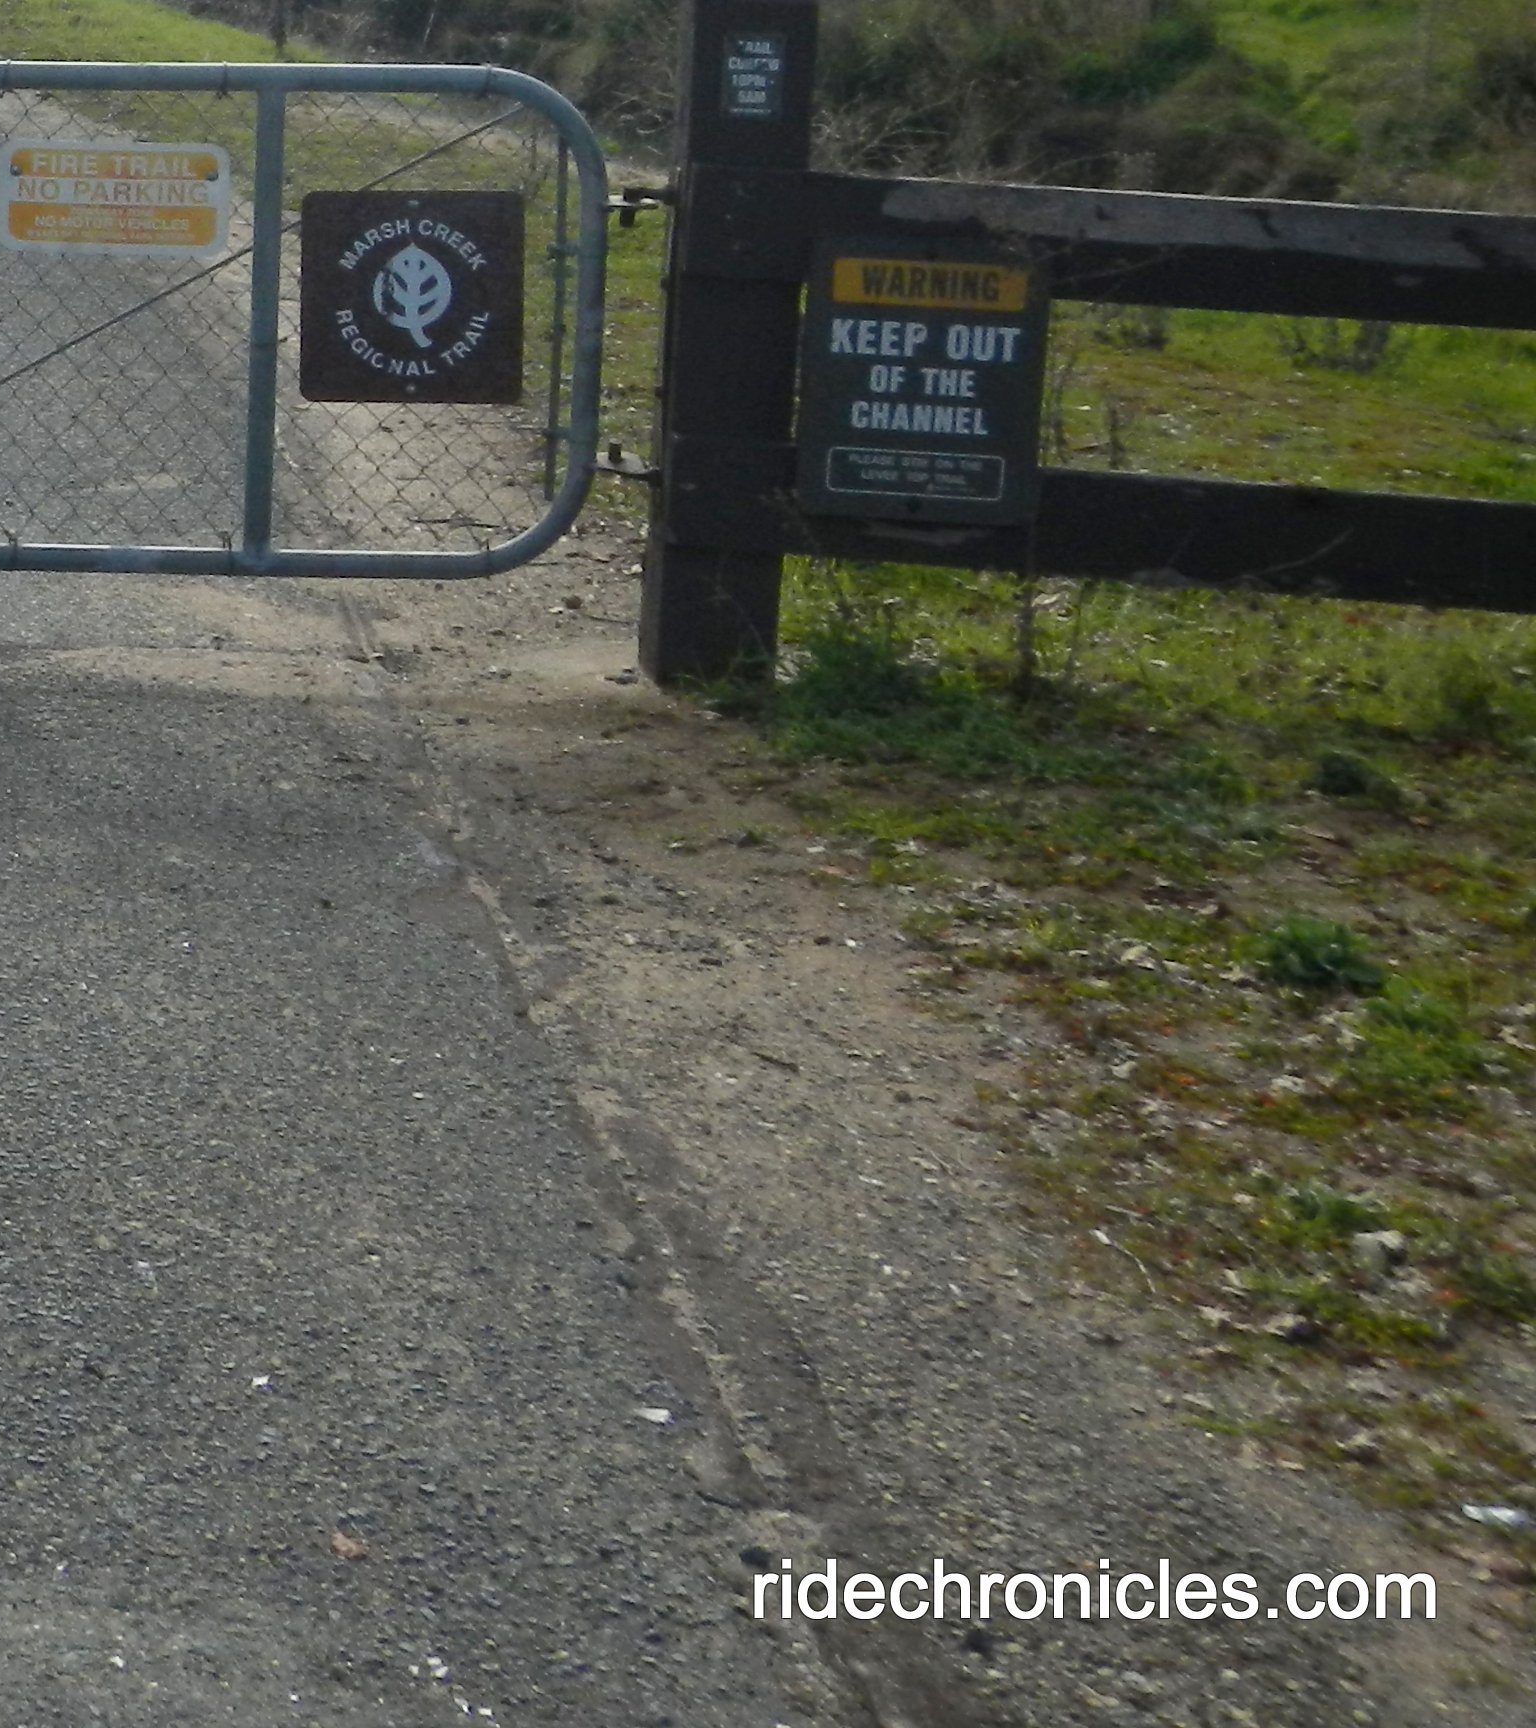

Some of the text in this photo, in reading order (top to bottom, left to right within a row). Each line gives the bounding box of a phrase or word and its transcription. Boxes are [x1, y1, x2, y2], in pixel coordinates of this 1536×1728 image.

[31, 152, 198, 178] FIRE TRAIL
[16, 178, 210, 204] NO PARKING
[33, 215, 57, 228] NO
[119, 218, 190, 231] VEHICLES
[336, 217, 488, 272] MARSH CREEK
[862, 264, 1000, 303] WARNING
[439, 310, 490, 367] TRAIL
[830, 317, 1022, 363] KEEP OUT
[869, 364, 977, 399] OF THE
[850, 400, 990, 436] CHANNEL
